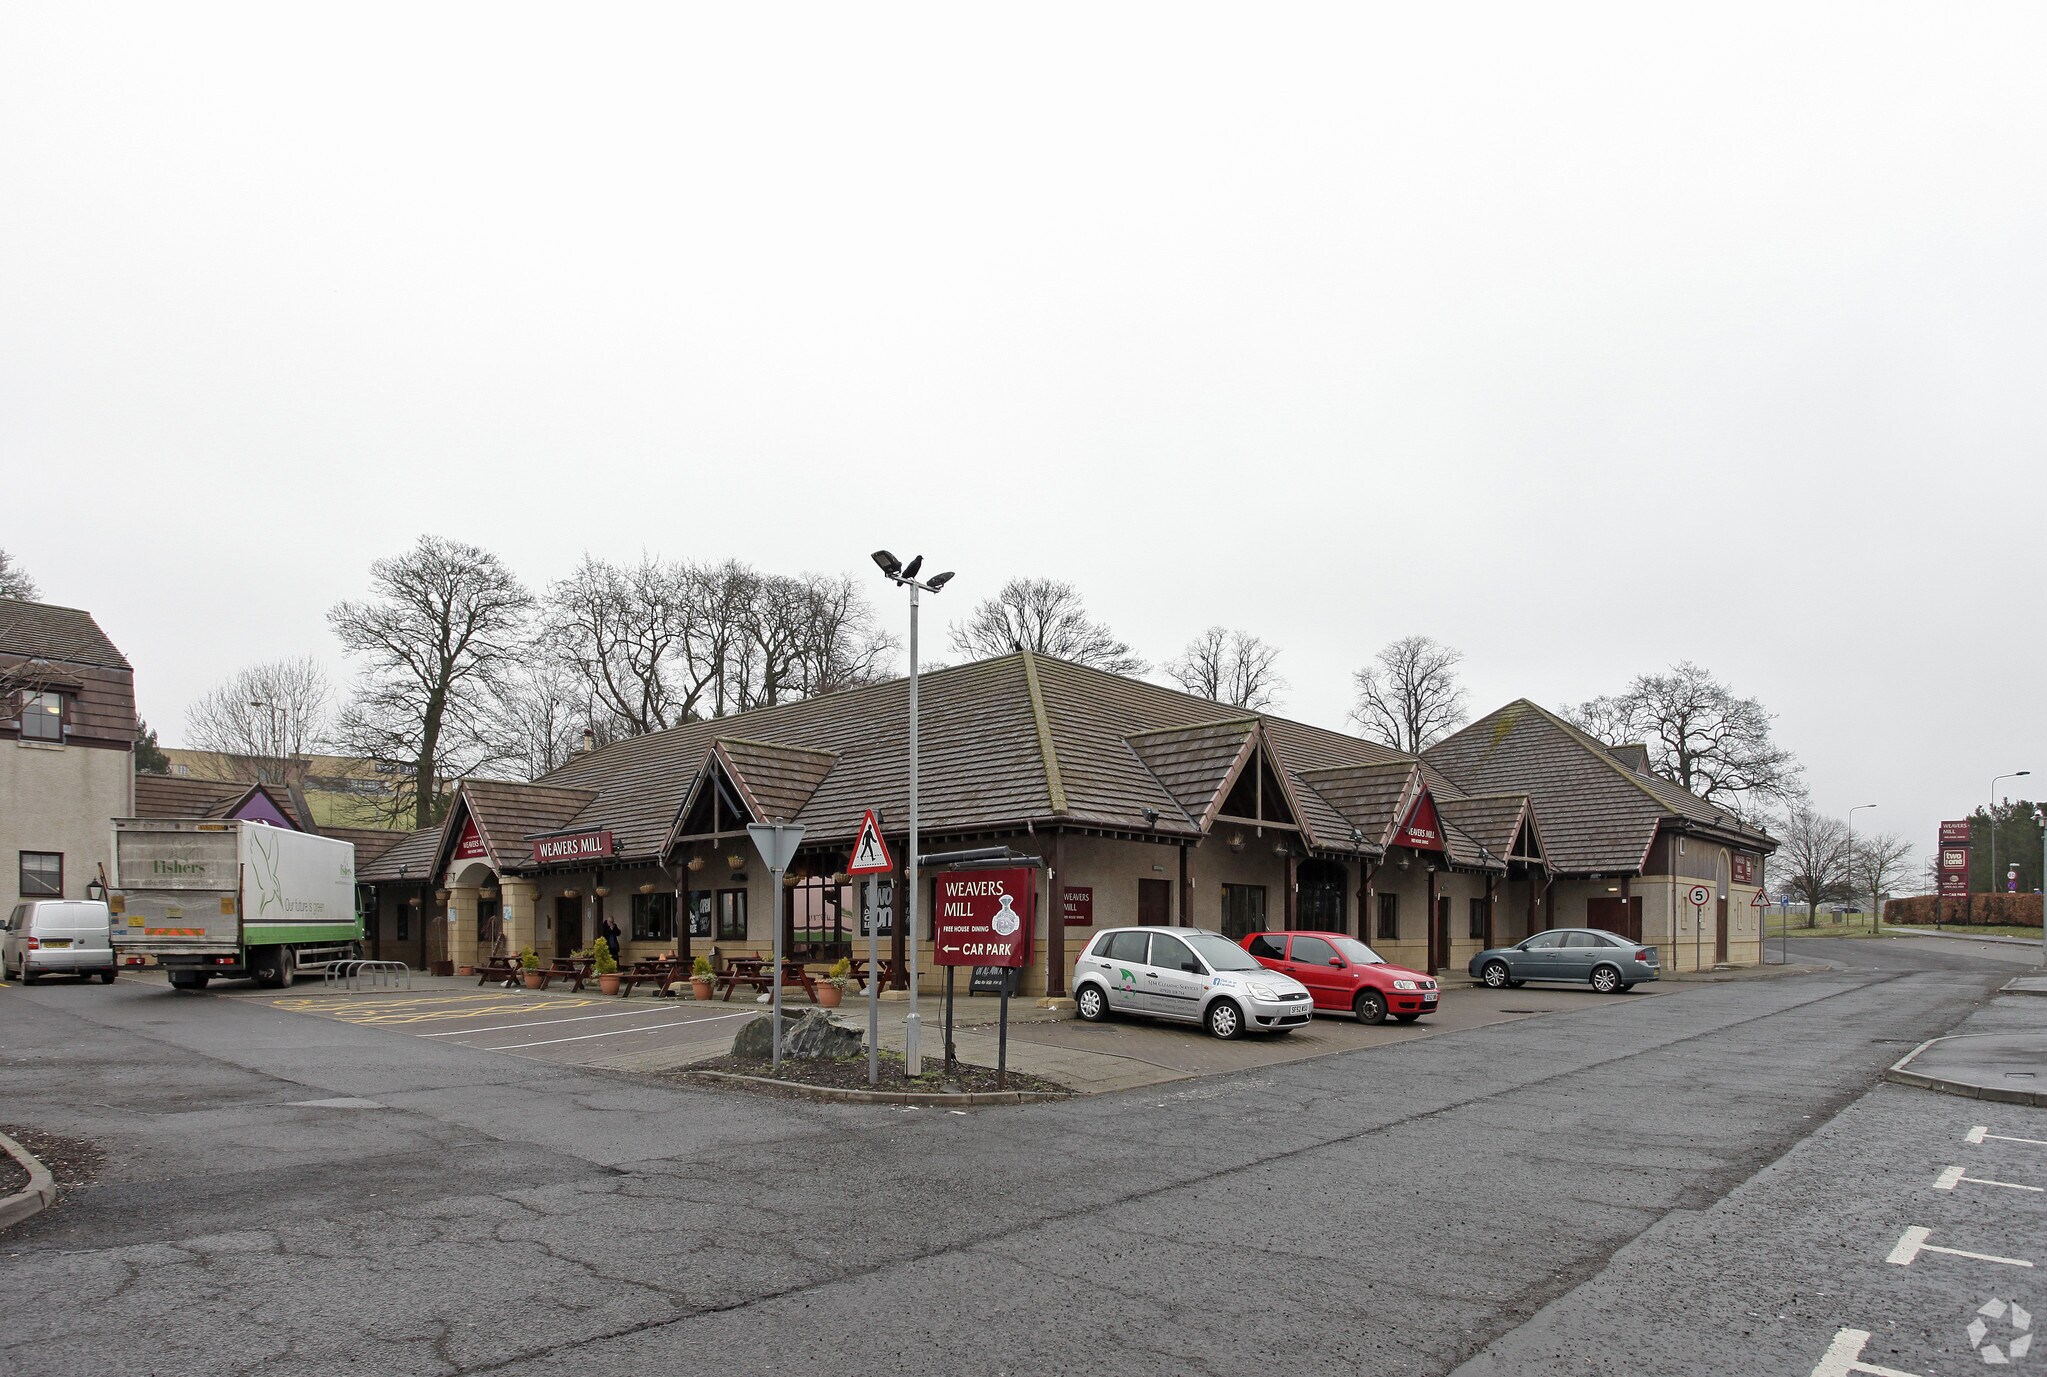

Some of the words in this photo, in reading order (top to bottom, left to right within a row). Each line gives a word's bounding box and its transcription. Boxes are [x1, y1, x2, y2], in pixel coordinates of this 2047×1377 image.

[1426, 830, 1434, 838] MILL
[540, 839, 579, 857] WEAVERS
[581, 837, 603, 853] MILL
[153, 860, 206, 874] Fishers
[945, 880, 1004, 897] WEAVERS
[1064, 893, 1089, 901] WEAVERS
[1695, 891, 1703, 901] 5
[944, 902, 974, 917] MILL
[943, 925, 953, 933] FREE
[962, 942, 984, 956] CAR
[986, 943, 1012, 956] PARK
